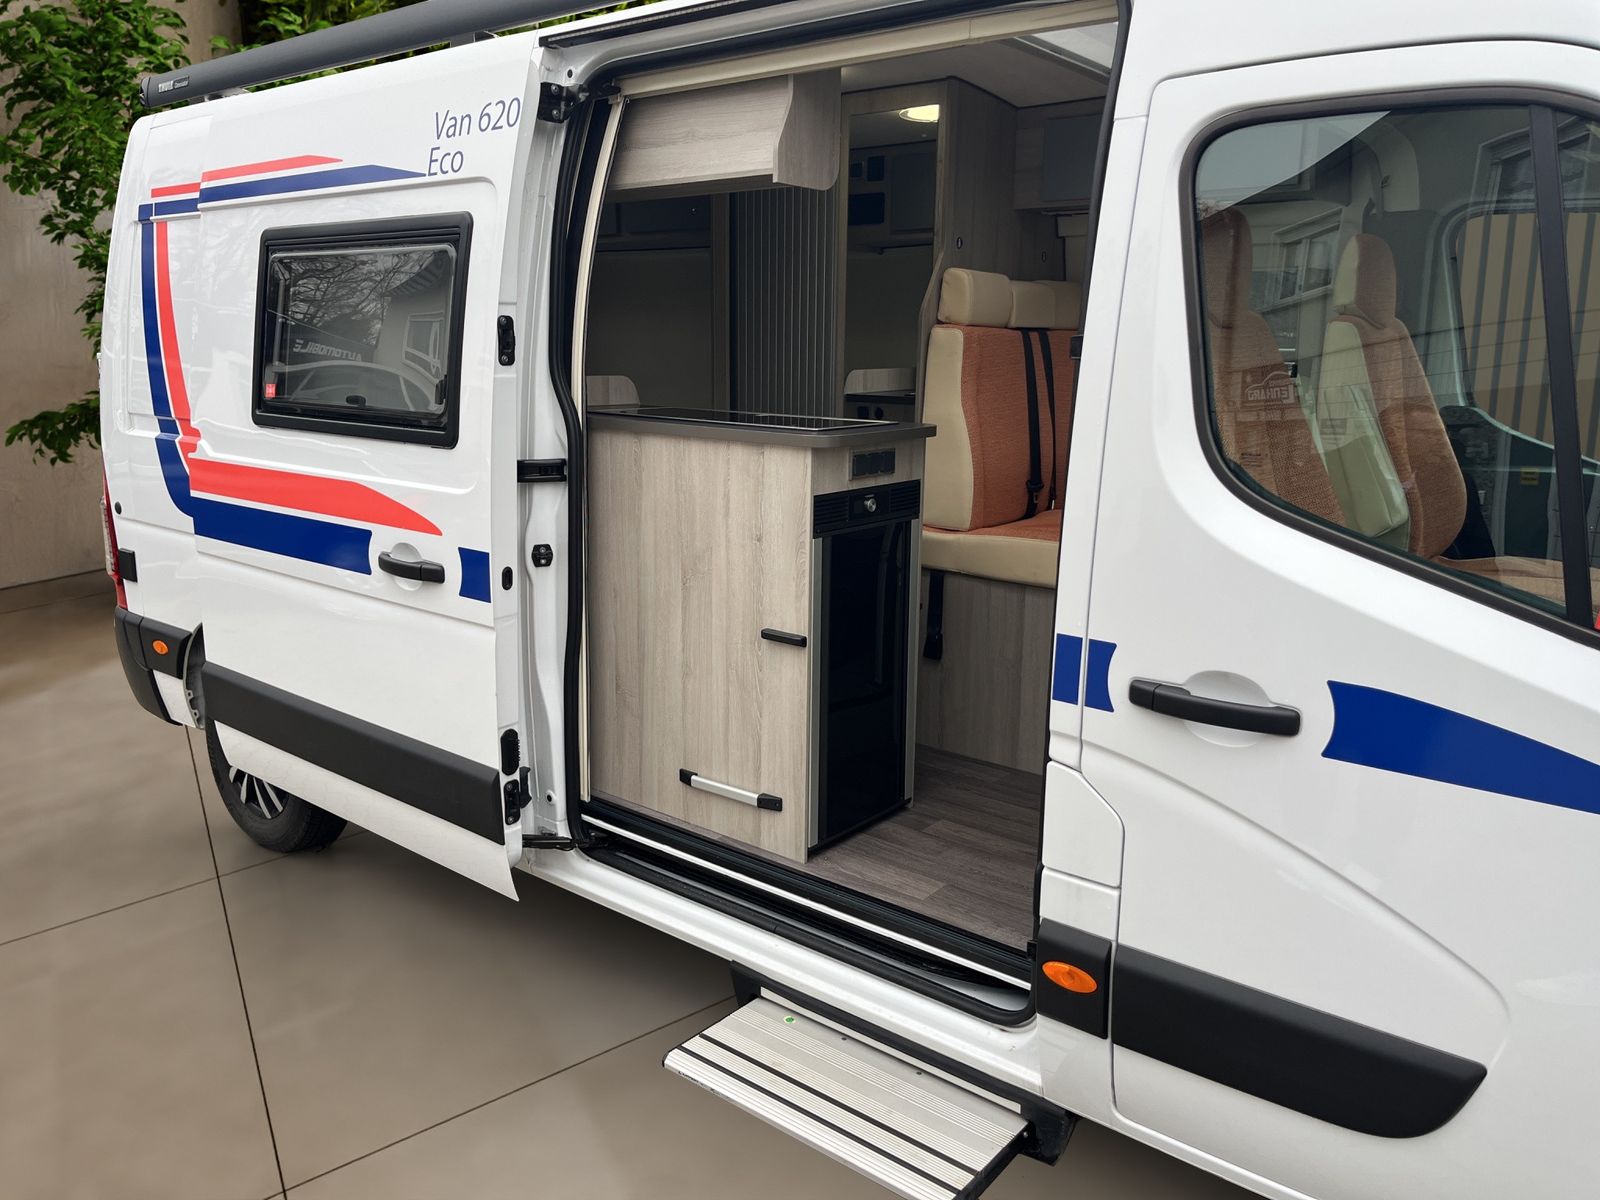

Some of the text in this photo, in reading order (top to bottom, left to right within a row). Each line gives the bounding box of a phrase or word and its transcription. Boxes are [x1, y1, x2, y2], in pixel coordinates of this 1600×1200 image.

[435, 97, 521, 140] Van 620
[427, 146, 464, 177] Eco
